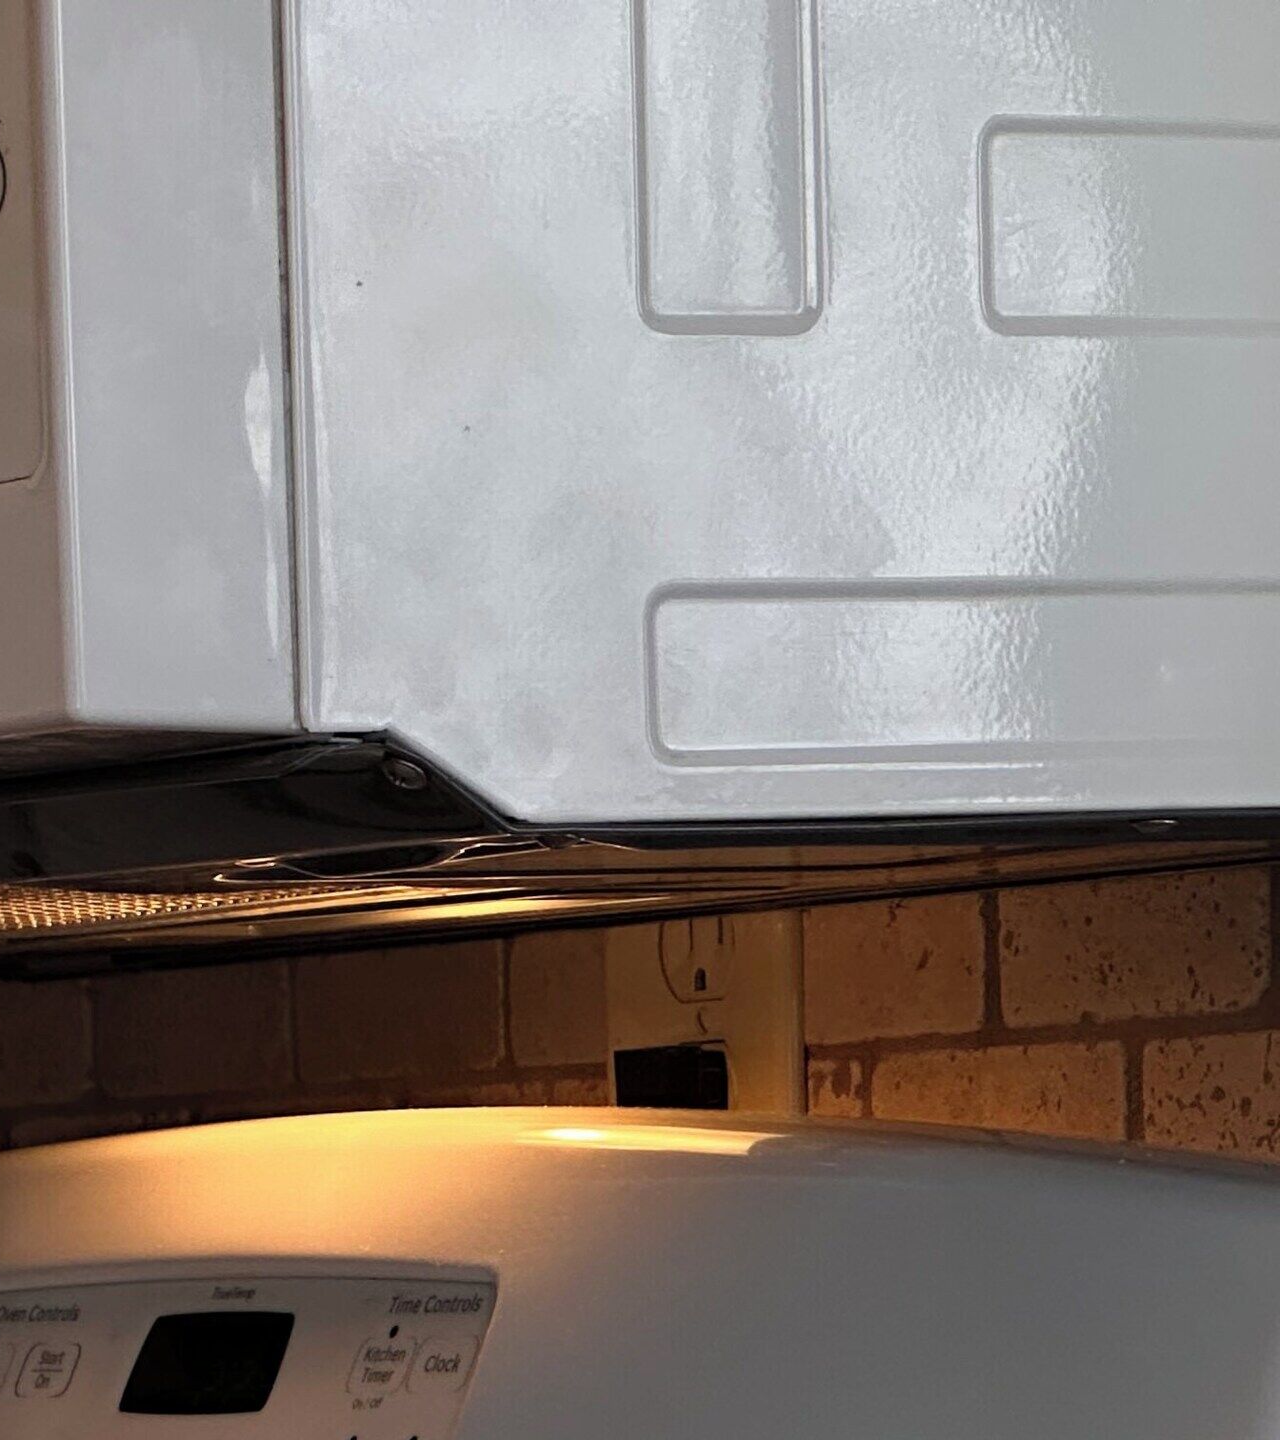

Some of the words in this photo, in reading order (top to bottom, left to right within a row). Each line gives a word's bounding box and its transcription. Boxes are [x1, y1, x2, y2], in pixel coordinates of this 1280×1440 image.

[28, 1303, 79, 1322] Controls
[389, 1296, 421, 1314] Time
[424, 1292, 482, 1314] Controls
[363, 1346, 406, 1362] Kitchen
[424, 1353, 461, 1373] Clock
[361, 1367, 395, 1383] Timer
